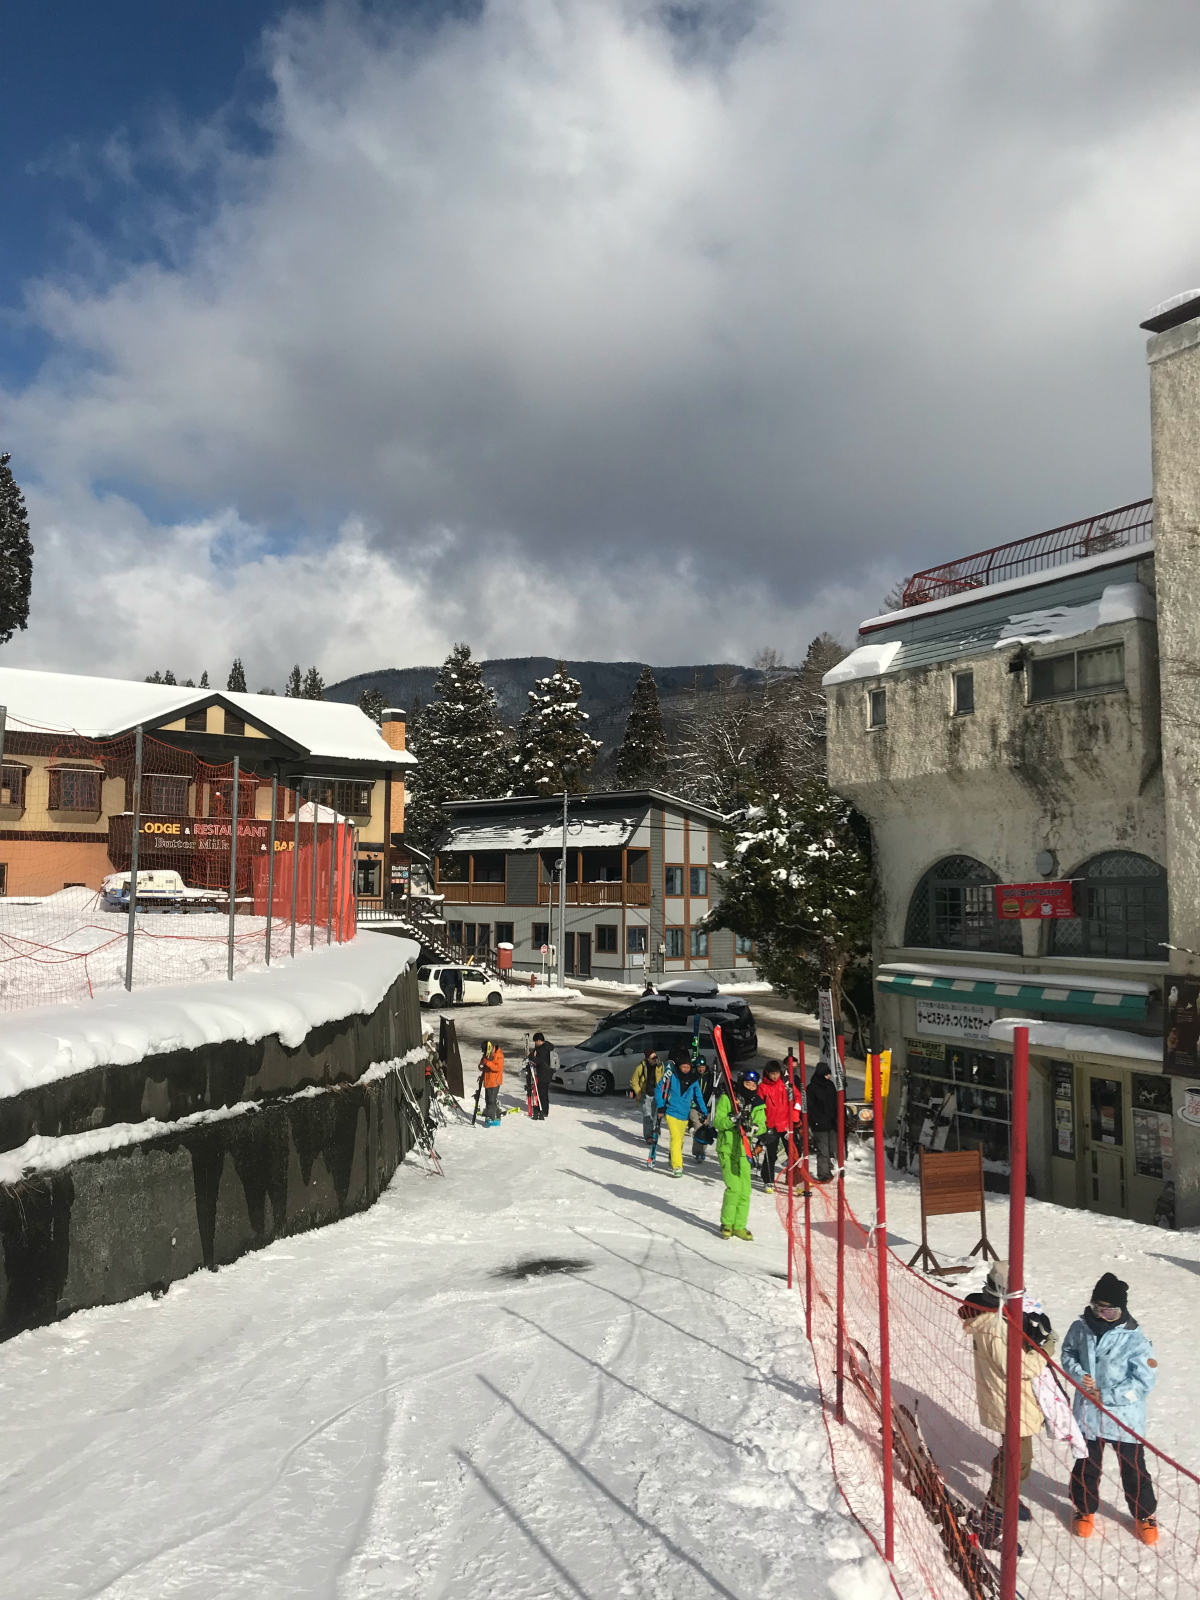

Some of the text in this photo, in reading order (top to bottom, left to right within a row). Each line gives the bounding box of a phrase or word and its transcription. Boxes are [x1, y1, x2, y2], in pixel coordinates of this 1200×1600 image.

[184, 827, 190, 835] &
[193, 823, 268, 838] RESTAURANT
[154, 837, 230, 850] Butter Milk
[260, 843, 267, 851] &
